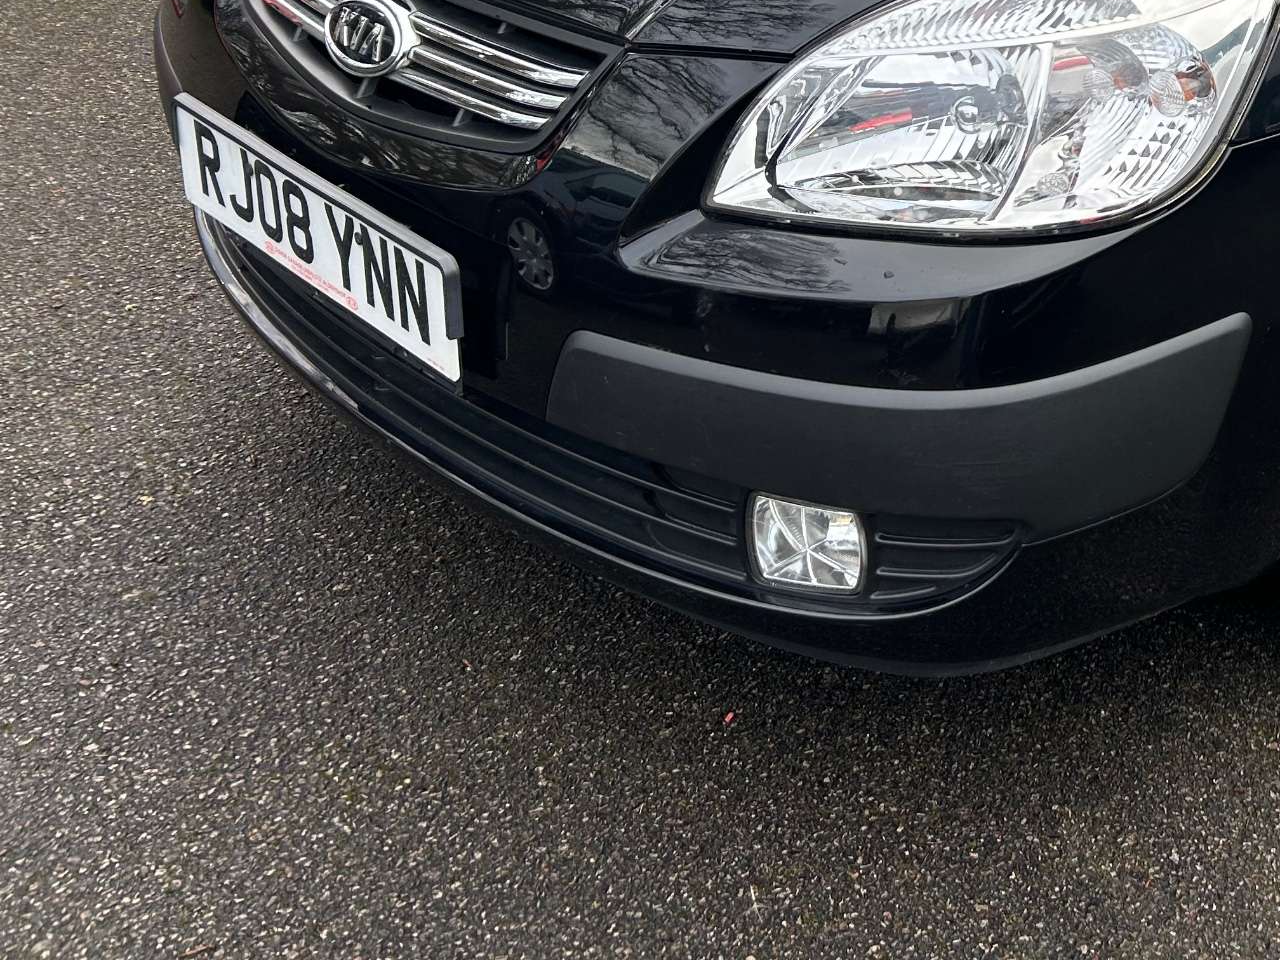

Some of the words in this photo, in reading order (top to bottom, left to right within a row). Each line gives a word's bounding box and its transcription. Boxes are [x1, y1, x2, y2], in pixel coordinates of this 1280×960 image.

[333, 6, 386, 62] KIA
[194, 119, 314, 265] RJ08
[325, 201, 432, 346] YNN
